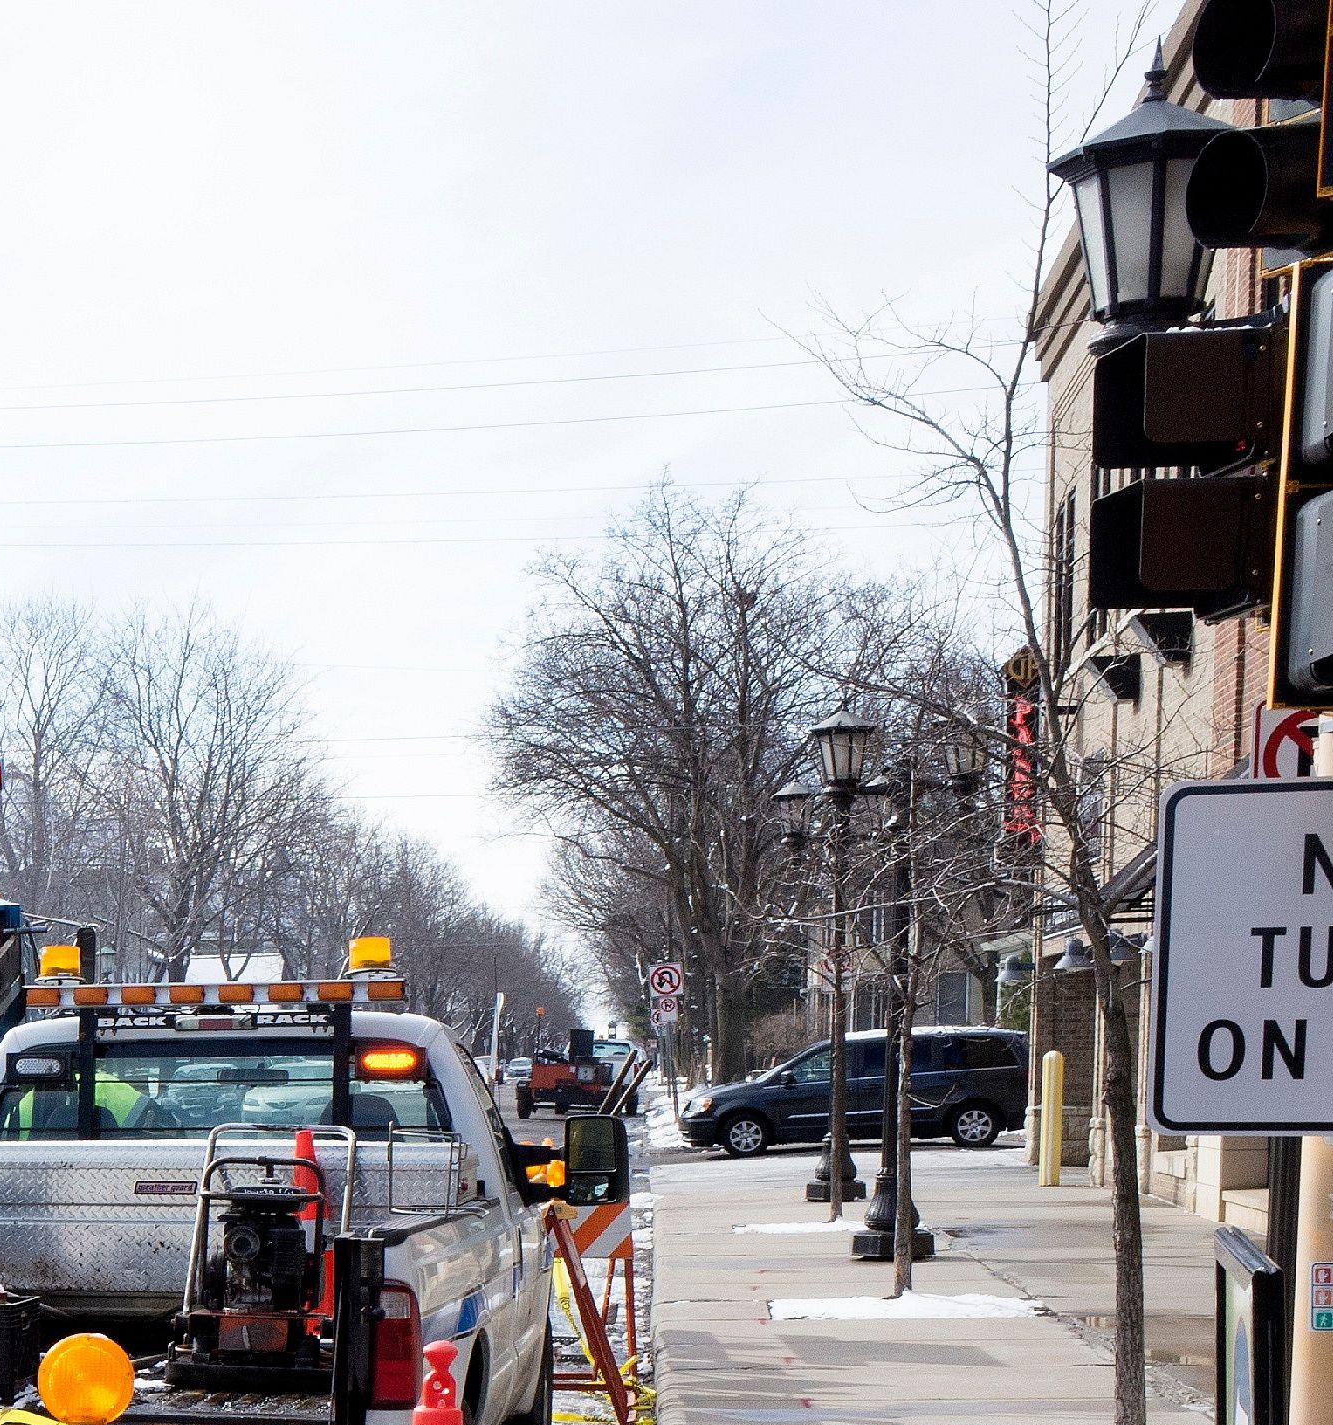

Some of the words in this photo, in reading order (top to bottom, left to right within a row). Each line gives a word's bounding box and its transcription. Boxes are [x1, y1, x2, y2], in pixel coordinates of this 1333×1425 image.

[97, 1016, 167, 1028] BACK
[256, 1013, 329, 1025] RACK
[1197, 1018, 1307, 1081] ON
